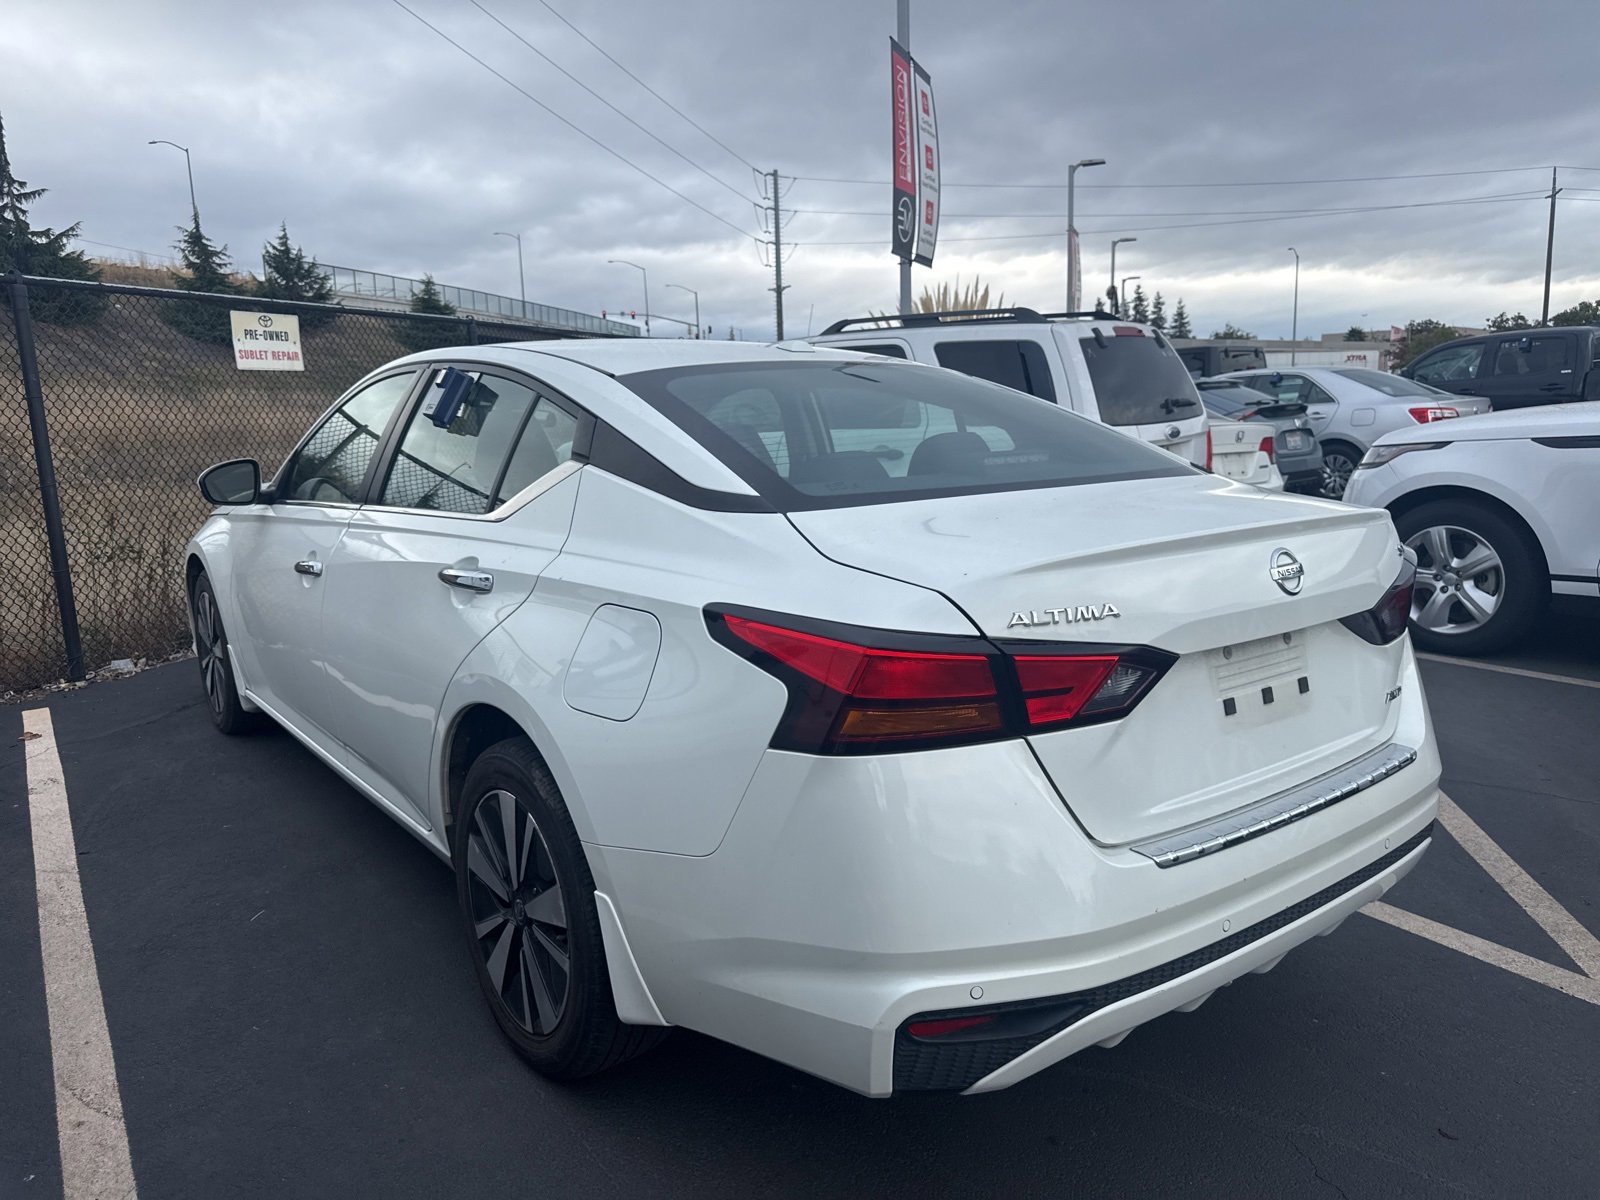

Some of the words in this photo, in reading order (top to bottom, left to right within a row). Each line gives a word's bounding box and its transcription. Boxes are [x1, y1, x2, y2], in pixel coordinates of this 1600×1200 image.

[896, 64, 907, 181] ENVISION
[244, 329, 289, 342] PRE-OWNED
[238, 349, 268, 360] SUBLET
[271, 351, 300, 361] REPAIR
[1007, 603, 1121, 629] ALTIMA
